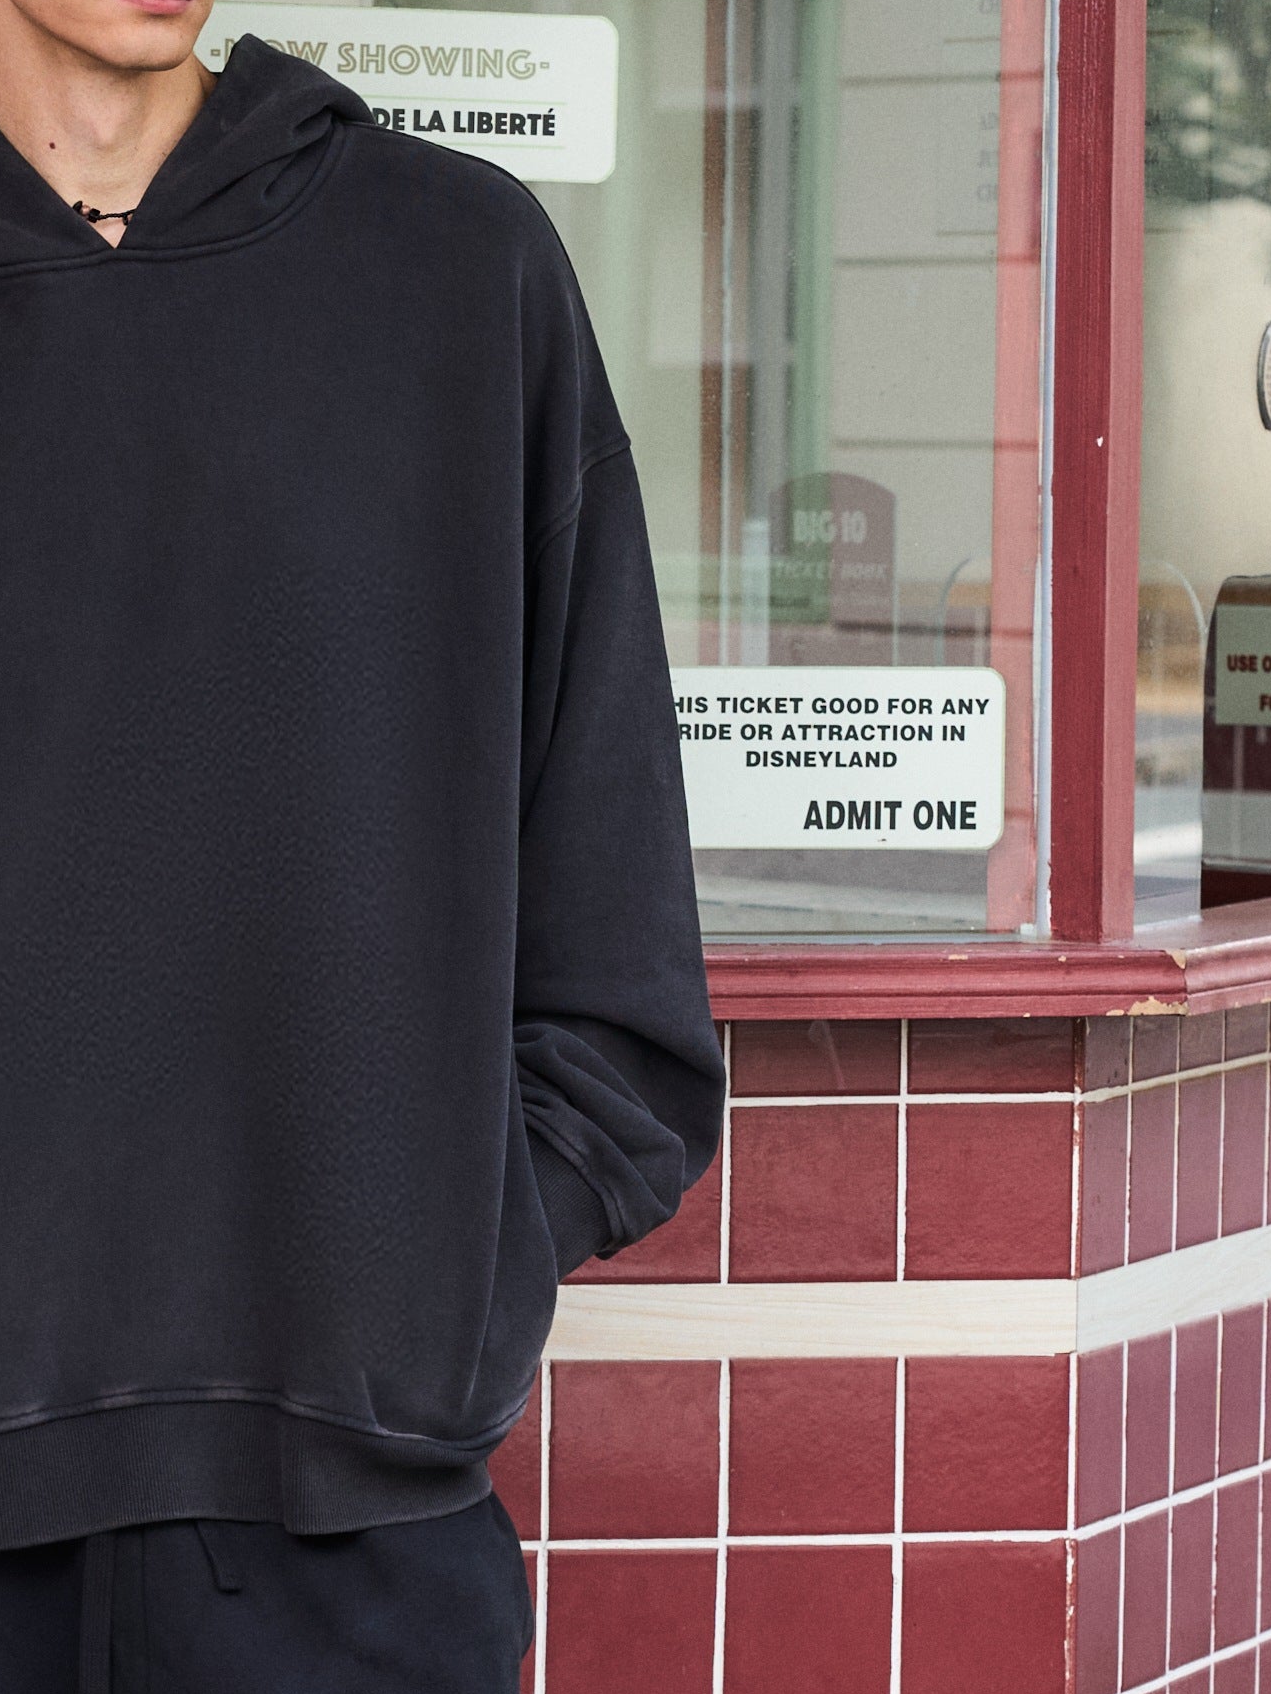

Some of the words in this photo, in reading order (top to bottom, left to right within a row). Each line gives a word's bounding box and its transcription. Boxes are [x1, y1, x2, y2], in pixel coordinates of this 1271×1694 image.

[372, 107, 405, 131] DE
[413, 109, 446, 133] LA
[453, 108, 557, 138] LIBERTÉ
[1226, 654, 1258, 673] USE
[716, 696, 804, 714] TICKET
[811, 697, 879, 715] GOOD
[887, 698, 933, 715] FOR
[941, 698, 990, 715] ANY
[679, 723, 732, 741] RIDE
[740, 723, 773, 741] OR
[781, 724, 933, 742] ATTRACTION
[942, 725, 966, 742] IN
[746, 750, 897, 768] DISNEYLAND
[803, 800, 902, 830] ADMIT
[913, 799, 977, 831] ONE
